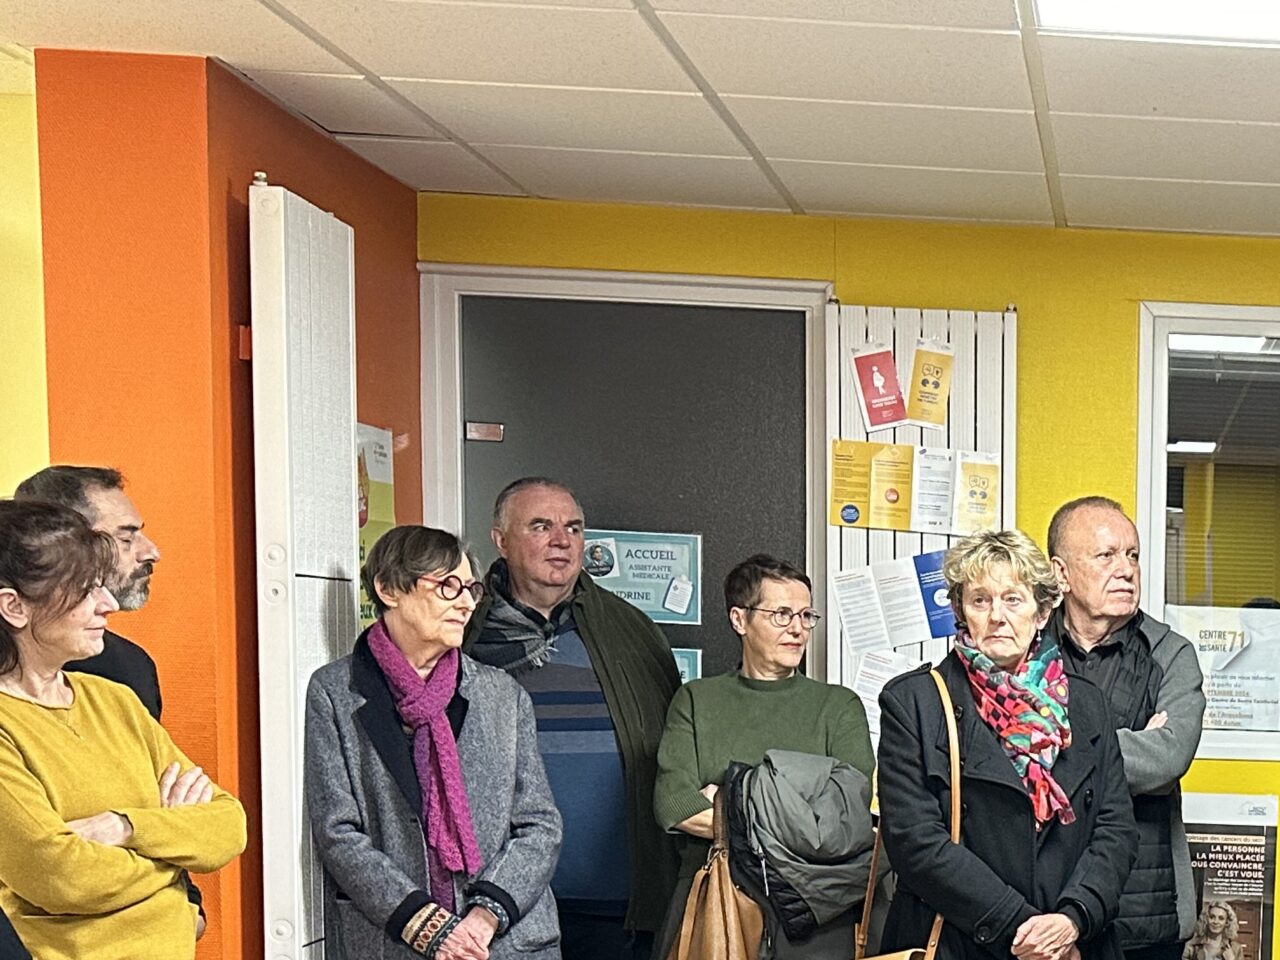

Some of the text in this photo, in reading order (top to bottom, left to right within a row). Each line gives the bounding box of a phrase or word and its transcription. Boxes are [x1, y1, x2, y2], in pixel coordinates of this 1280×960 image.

[625, 549, 677, 561] ACCUEIL
[629, 564, 672, 572] ASSISTANTE
[1199, 630, 1245, 652] CENTRE 71
[1223, 845, 1266, 854] PERSONNE
[1197, 852, 1207, 860] LA
[1208, 853, 1235, 861] MIEUX
[1217, 870, 1240, 878] C'EST
